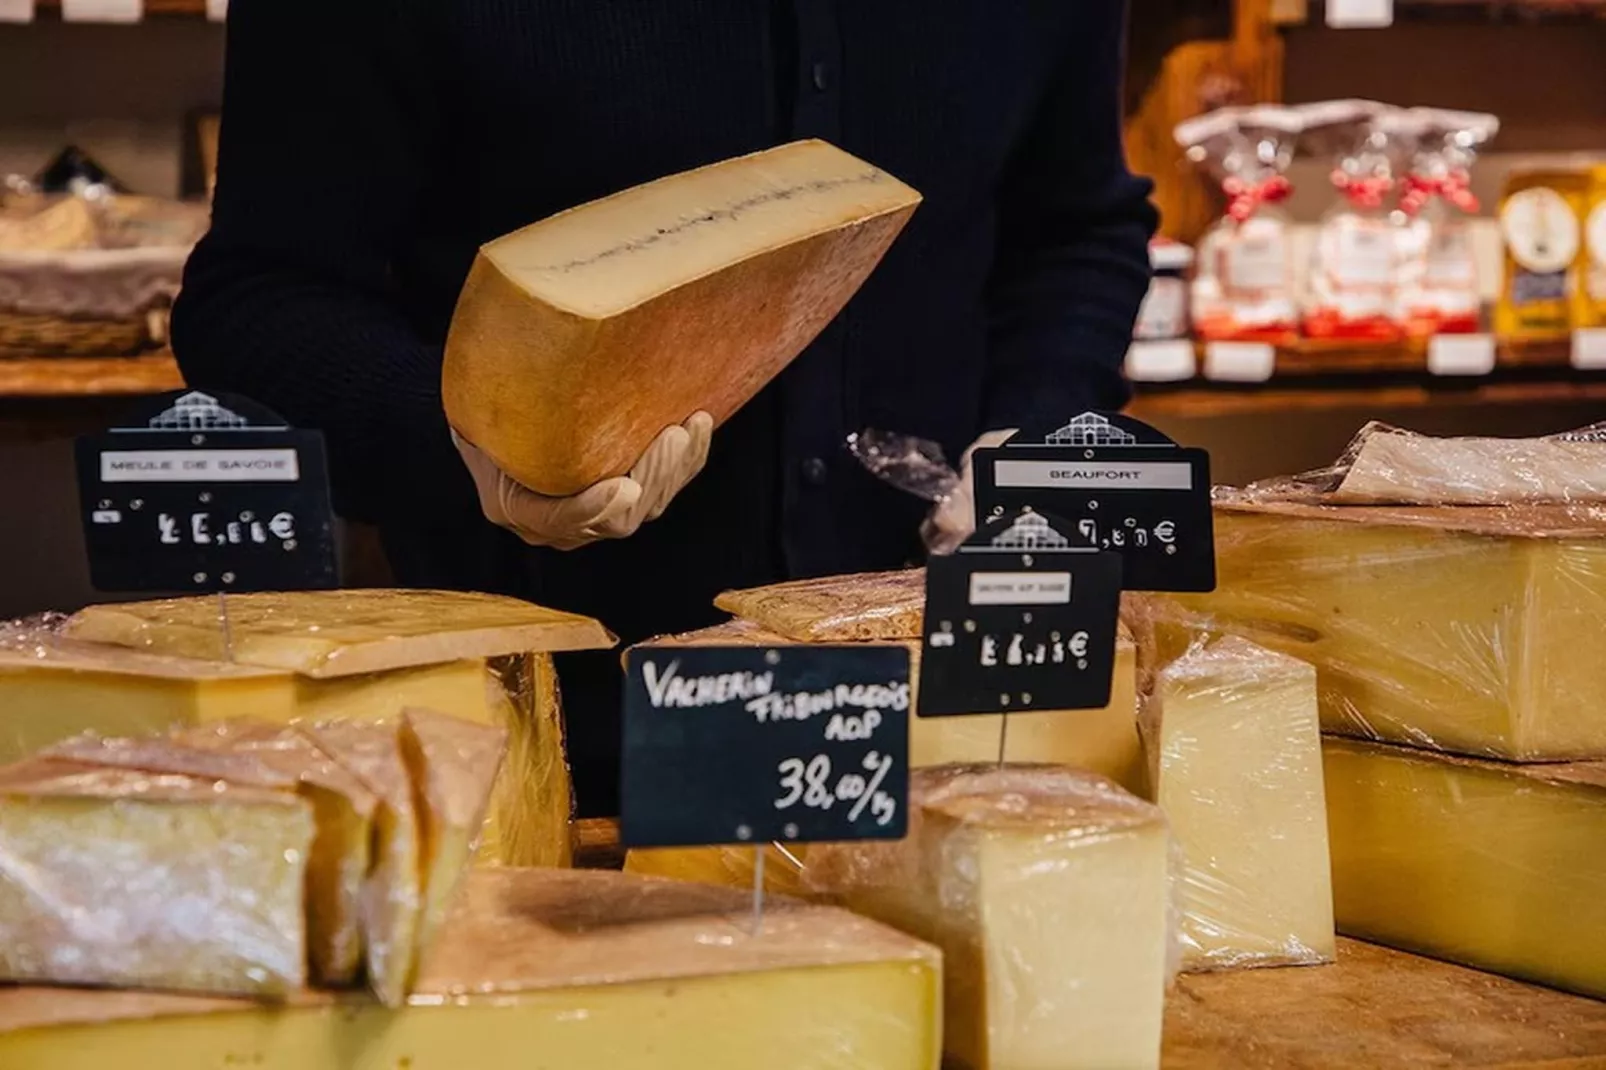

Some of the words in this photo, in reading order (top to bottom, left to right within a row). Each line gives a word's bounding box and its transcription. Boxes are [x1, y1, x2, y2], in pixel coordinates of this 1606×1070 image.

[110, 460, 172, 471] MEULE
[182, 460, 208, 470] DE
[218, 459, 287, 470] SAVOIE
[1049, 469, 1142, 480] BEAUFORT
[824, 709, 882, 741] AOP
